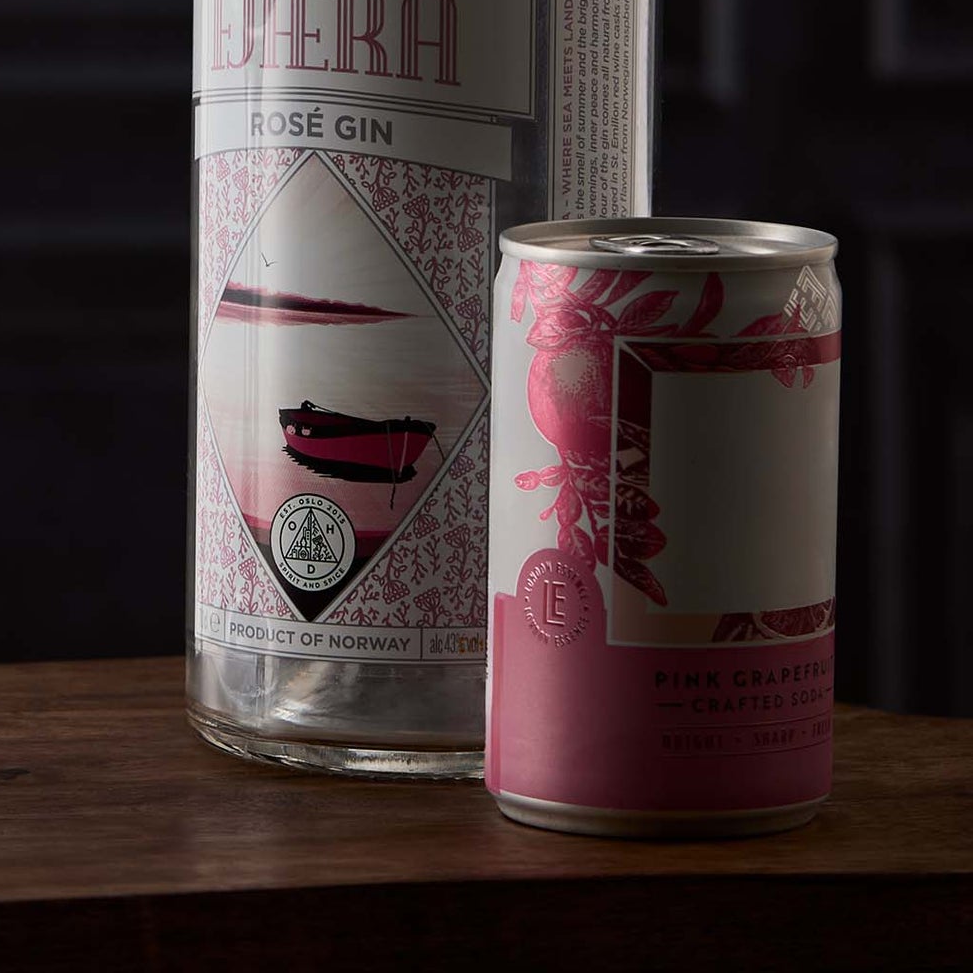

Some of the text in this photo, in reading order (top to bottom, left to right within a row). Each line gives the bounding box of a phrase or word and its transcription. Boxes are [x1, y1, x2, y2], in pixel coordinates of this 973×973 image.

[578, 27, 586, 48] the
[602, 19, 610, 62] natural
[563, 47, 573, 96] MEETS
[577, 52, 586, 76] and
[590, 50, 598, 75] and
[590, 78, 599, 117] peace
[621, 50, 630, 120] Norwegian
[563, 102, 572, 132] SEA
[578, 79, 586, 132] summer
[251, 107, 393, 145] ROSÉ GIN
[588, 120, 597, 152] inner
[611, 102, 619, 148] Emilion
[577, 135, 585, 149] of
[601, 130, 609, 149] gin
[563, 138, 572, 194] WHERE
[576, 152, 585, 186] smell
[600, 153, 608, 173] the
[588, 157, 598, 216] evenings,
[600, 176, 608, 190] of
[611, 173, 618, 183] in
[620, 156, 628, 202] flavour
[576, 187, 585, 209] the
[299, 498, 323, 506] OSLO
[279, 562, 345, 589] SPIRIT AND SPICE
[229, 622, 410, 652] PRODUCT OF NORWAY
[430, 634, 442, 653] alc
[655, 670, 721, 689] PINK
[692, 689, 823, 713] CRAFTED SODA
